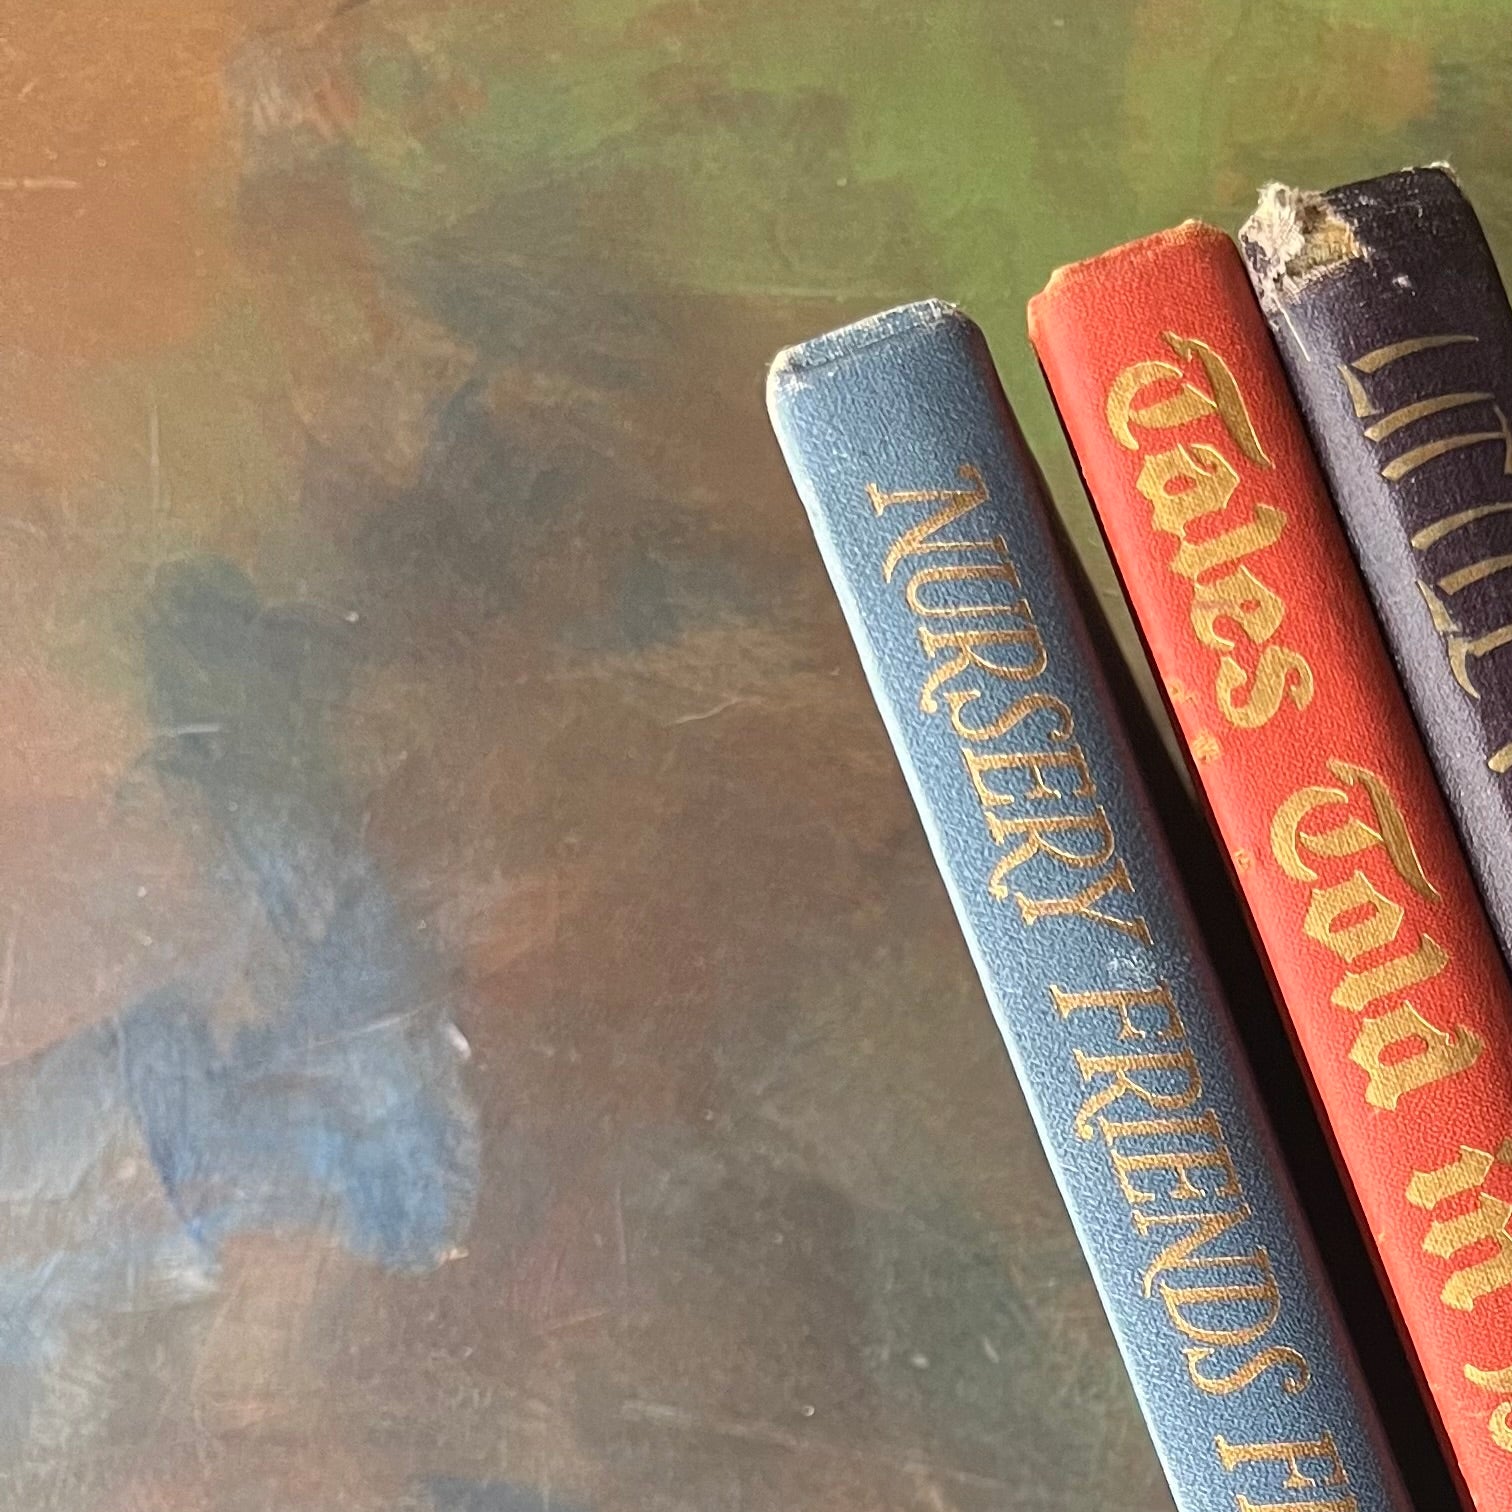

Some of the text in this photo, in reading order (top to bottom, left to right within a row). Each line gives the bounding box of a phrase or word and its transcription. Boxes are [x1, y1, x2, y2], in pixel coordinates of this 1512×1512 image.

[863, 459, 1154, 947] NURSERY
[1047, 977, 1313, 1397] FRIENDS
[1108, 328, 1314, 728] Tales
[1273, 757, 1489, 1110] Told
